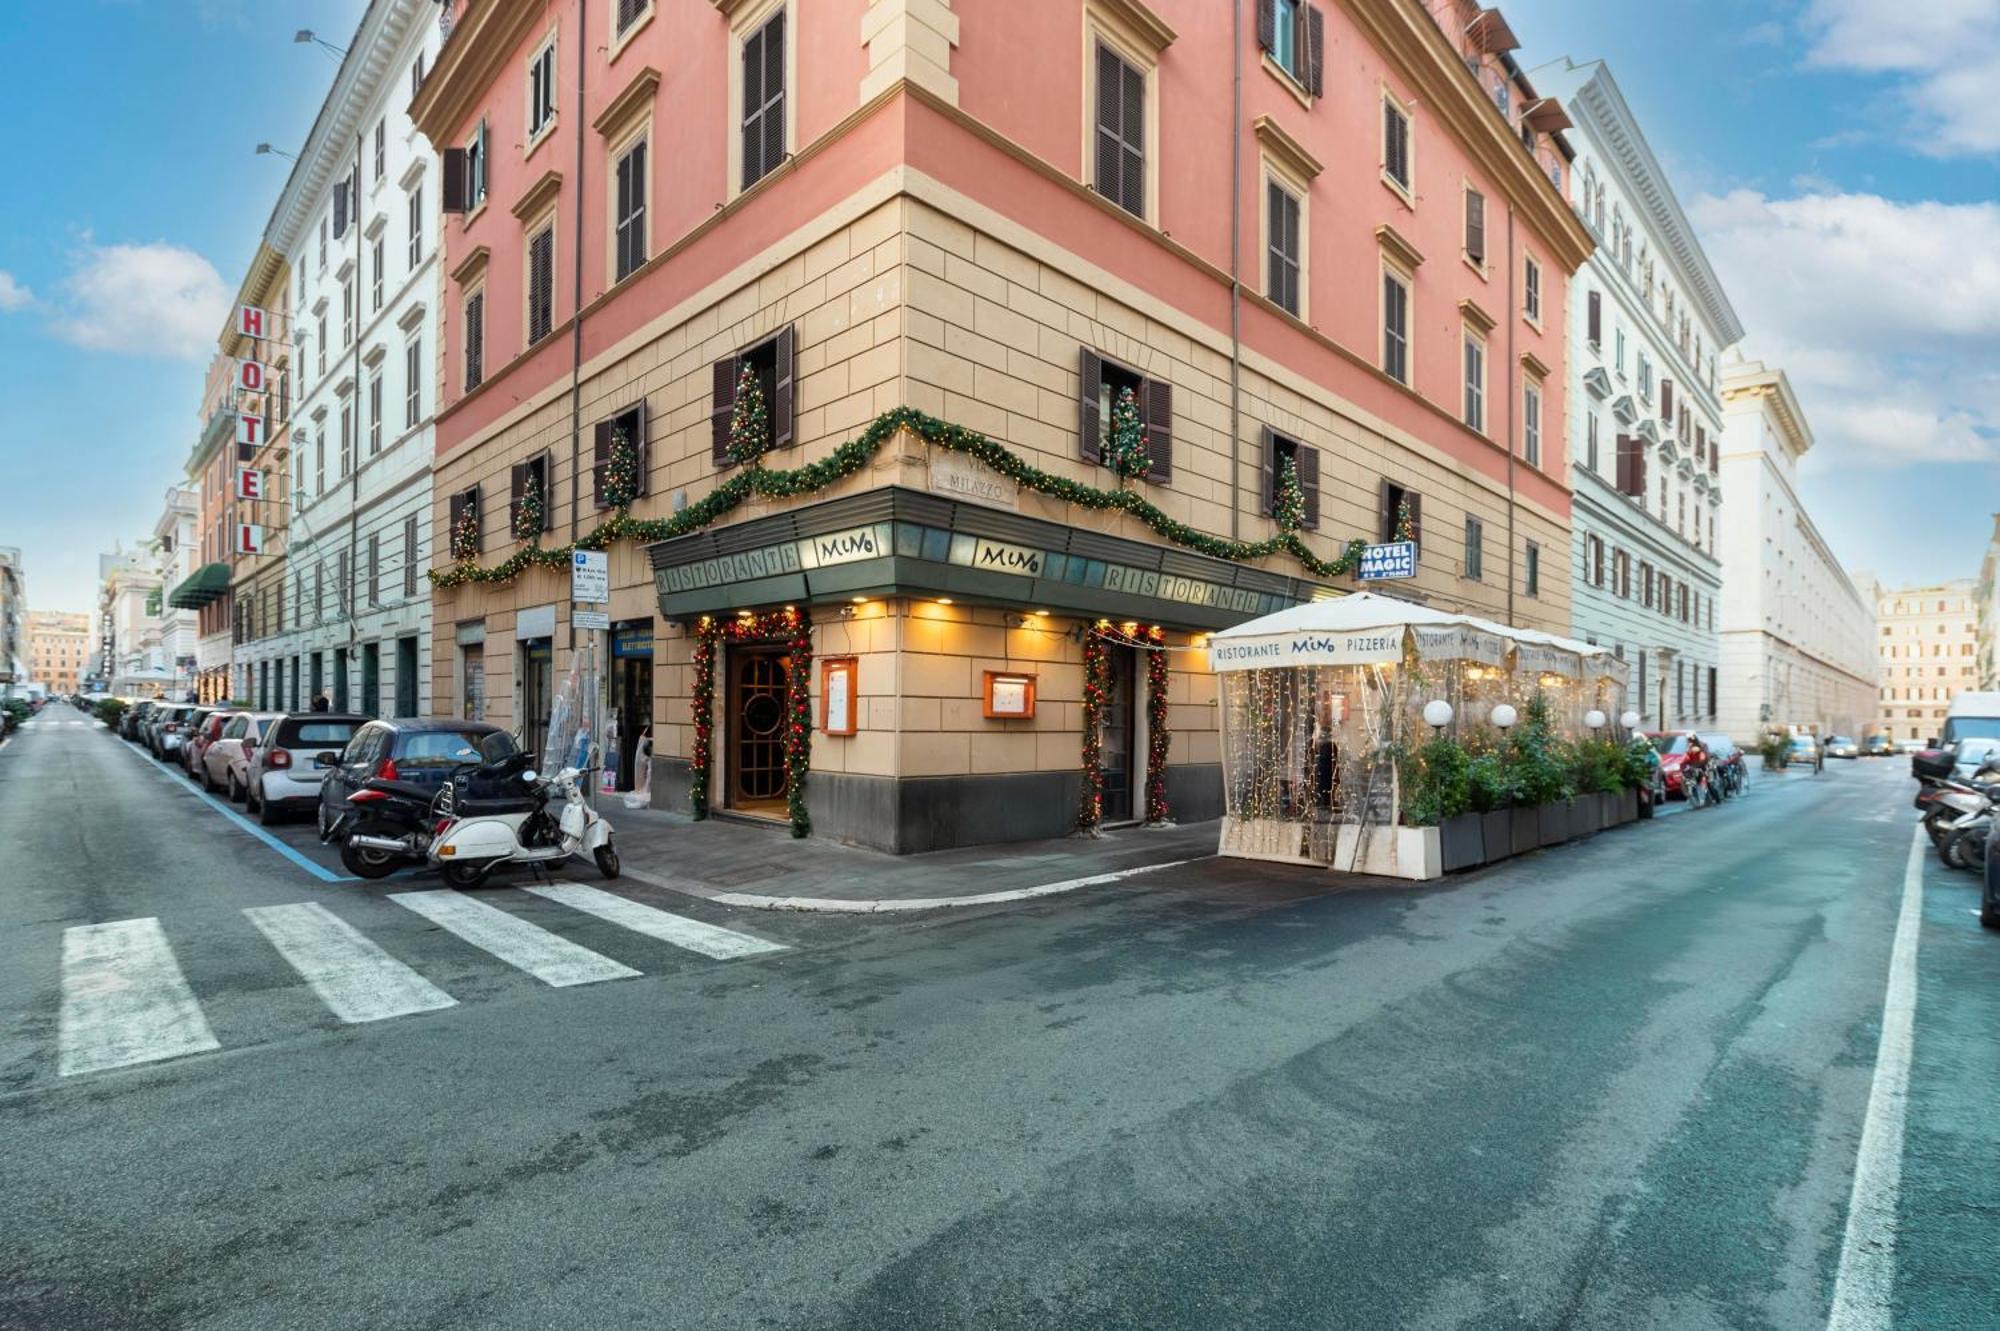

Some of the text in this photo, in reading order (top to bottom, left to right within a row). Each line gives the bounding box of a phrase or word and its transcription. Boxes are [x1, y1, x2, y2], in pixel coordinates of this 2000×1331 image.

[241, 307, 262, 552] HOTEL
[950, 473, 1002, 498] MILAZZO
[1360, 557, 1411, 572] MAGIC
[1361, 545, 1410, 559] HOTEL
[656, 546, 797, 592] RISTORANTE
[1108, 568, 1258, 612] RISTORANTE
[1217, 643, 1280, 660] RISTORANTE
[1347, 638, 1397, 652] PIZZERIA
